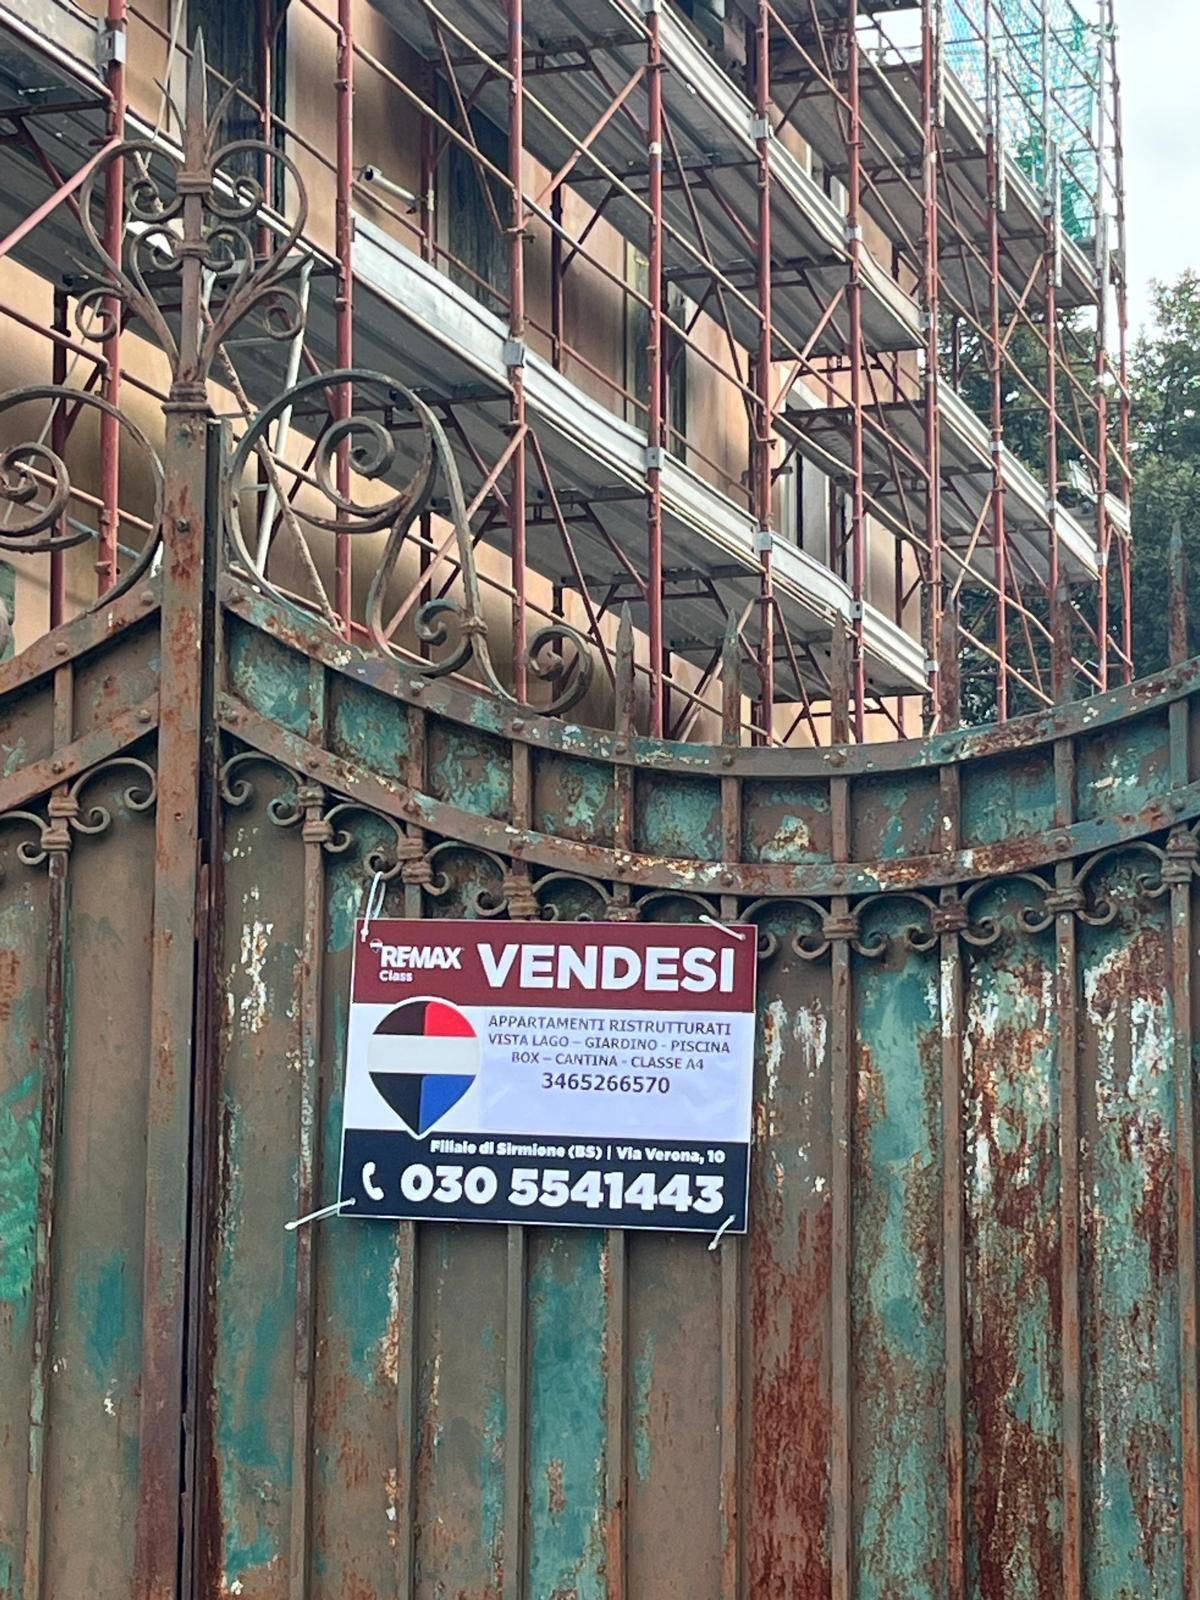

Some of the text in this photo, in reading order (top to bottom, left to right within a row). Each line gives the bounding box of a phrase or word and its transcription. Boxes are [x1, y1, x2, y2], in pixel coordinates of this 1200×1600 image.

[379, 970, 413, 982] Class
[476, 943, 735, 993] VENDESI
[488, 1015, 731, 1035] APPARTAMENTI RISTRUTTURATI
[488, 1033, 528, 1046] VISTA
[532, 1035, 569, 1047] LAGO
[584, 1037, 658, 1051] GIARDINO
[671, 1040, 730, 1053] PISCINA
[511, 1051, 540, 1064] BOX
[555, 1053, 618, 1066] CANTINA
[631, 1056, 682, 1069] CLASSE
[686, 1058, 704, 1070] A4
[542, 1072, 670, 1094] 3465266570
[430, 1139, 477, 1154] Filiale
[479, 1141, 494, 1155] di
[496, 1142, 565, 1157] Sirmione
[567, 1144, 602, 1160] (BS)
[616, 1146, 642, 1160] Via
[645, 1147, 704, 1164] Verona,
[707, 1149, 726, 1163] 10
[400, 1163, 724, 1214] 030 5541443
